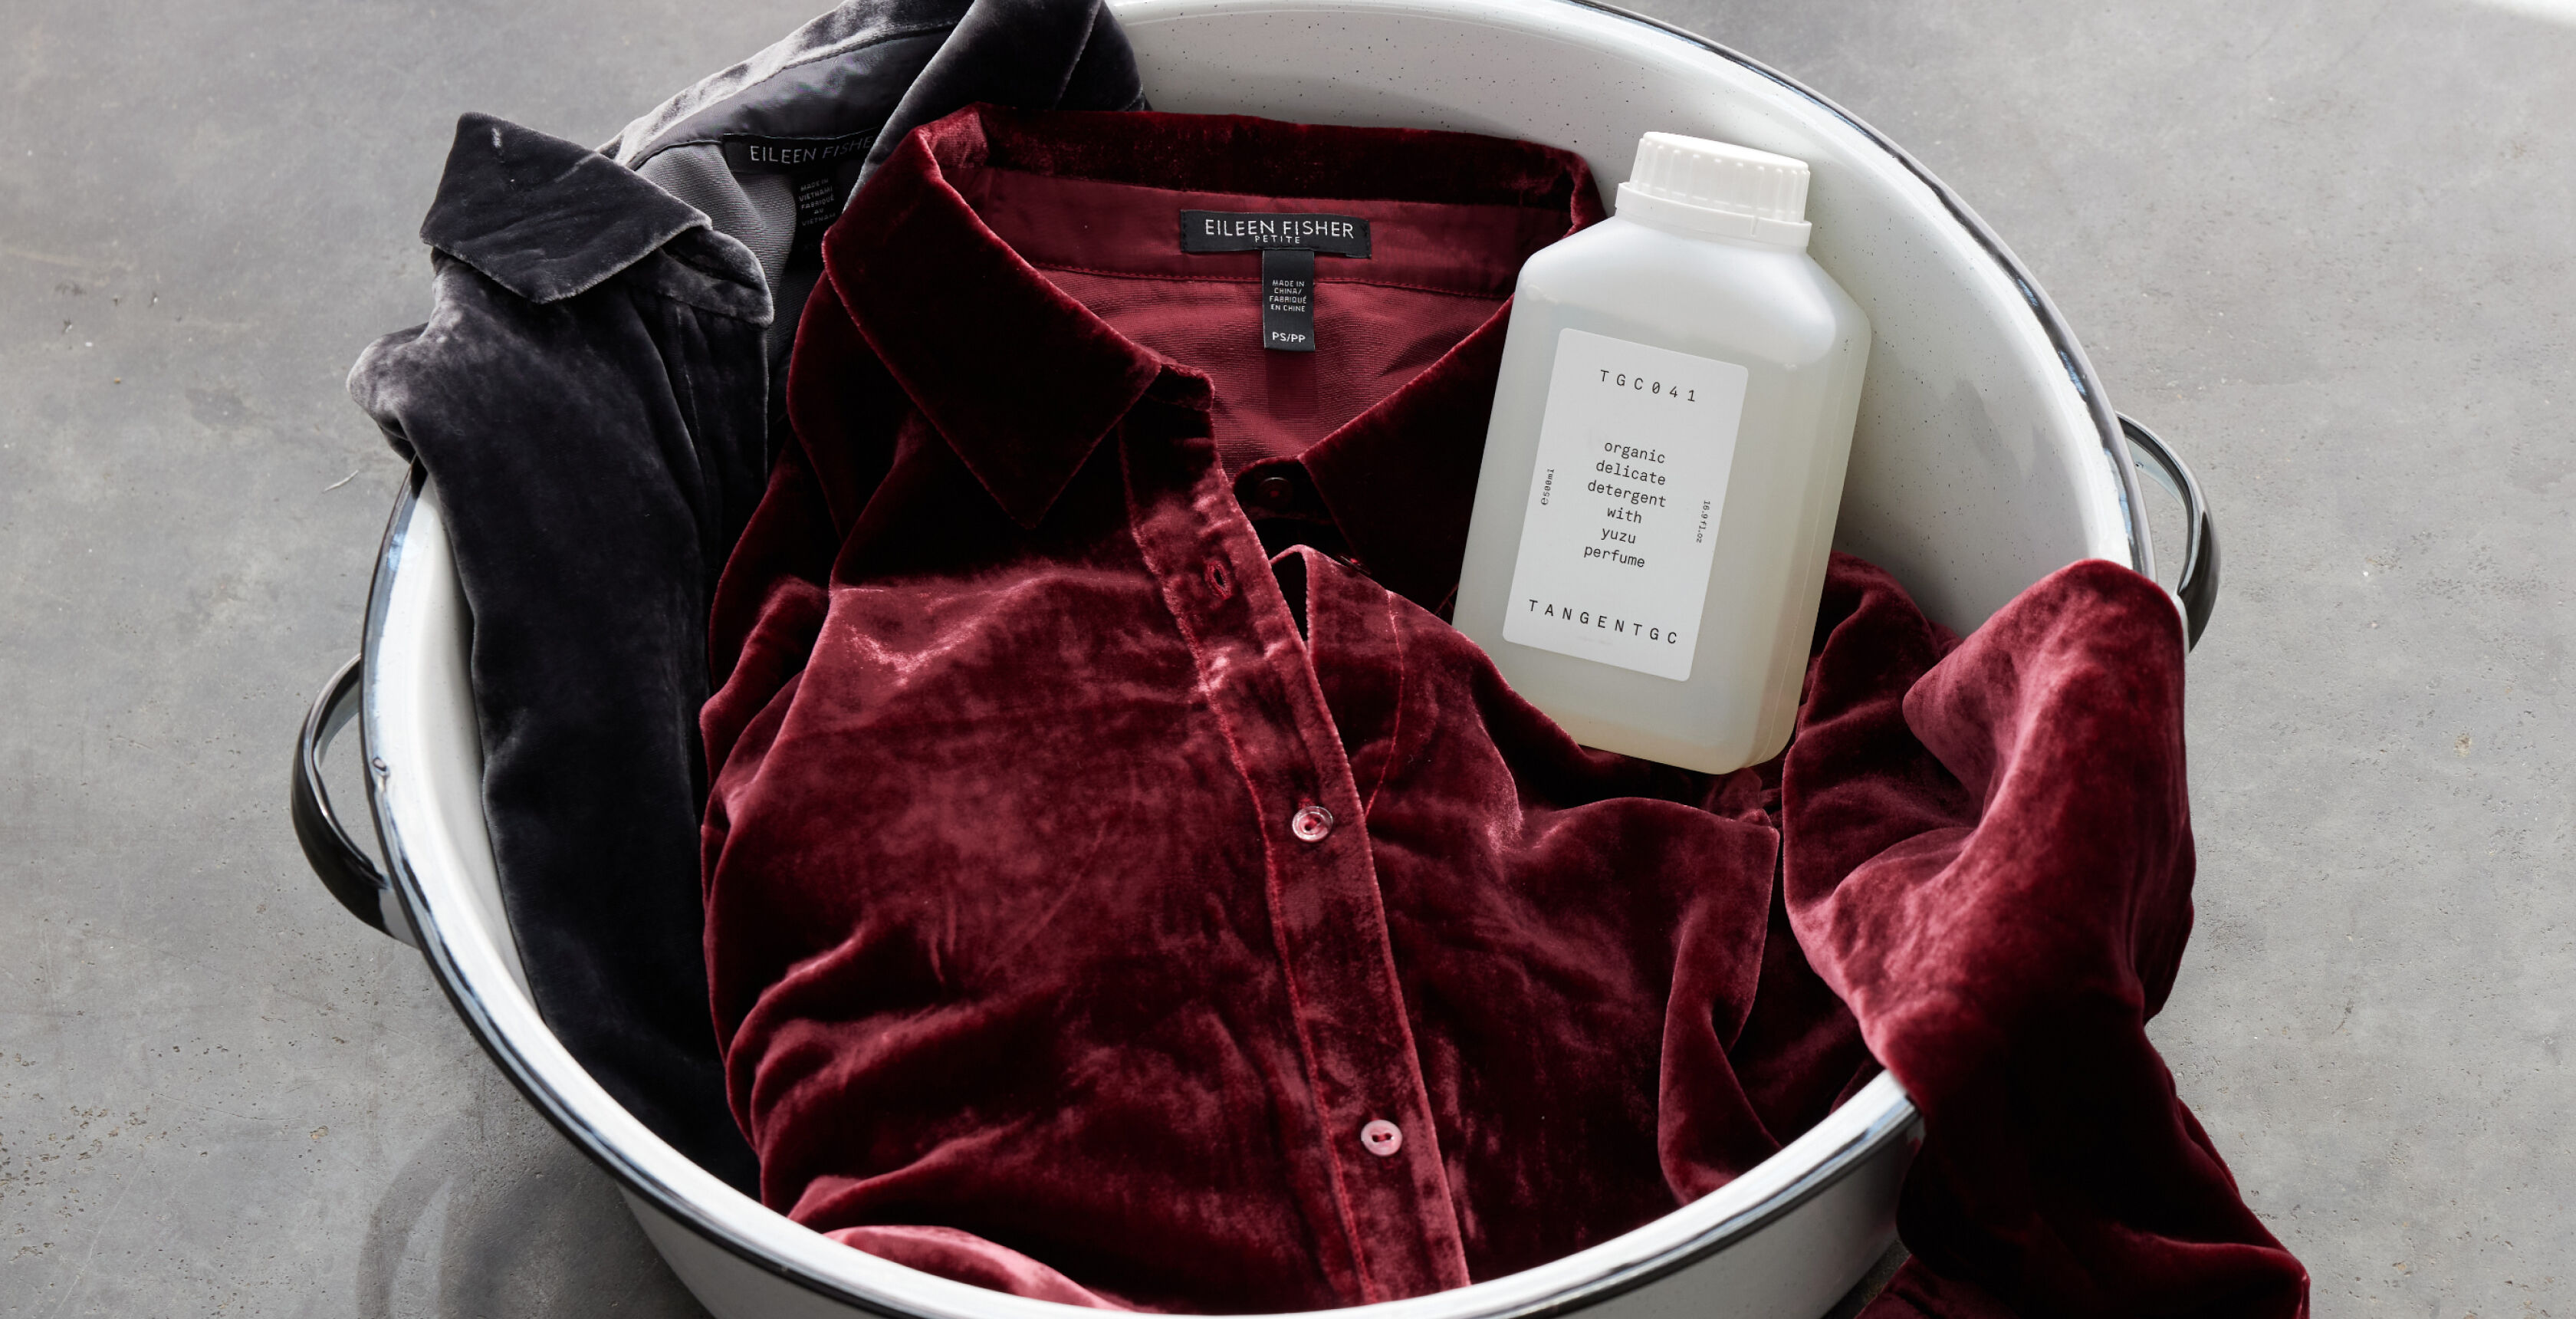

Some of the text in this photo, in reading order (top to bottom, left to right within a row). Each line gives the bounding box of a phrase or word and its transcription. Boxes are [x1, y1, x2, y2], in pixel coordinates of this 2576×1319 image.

[750, 136, 874, 164] EILEEN FISHE
[800, 180, 820, 192] MADE
[801, 212, 836, 226] VIETNAM
[1205, 219, 1354, 240] EILEEN FISHER
[1255, 235, 1301, 244] PETITE
[1272, 331, 1306, 343] PS/PP
[1600, 369, 1696, 403] TGC041
[1604, 440, 1666, 463] organic
[1595, 460, 1667, 486] delicate
[1587, 480, 1667, 508] detergent
[1606, 507, 1642, 524] with
[1601, 527, 1636, 544] yuzu
[1583, 546, 1645, 568] perfume
[1529, 599, 1677, 645] TANGENTGC
